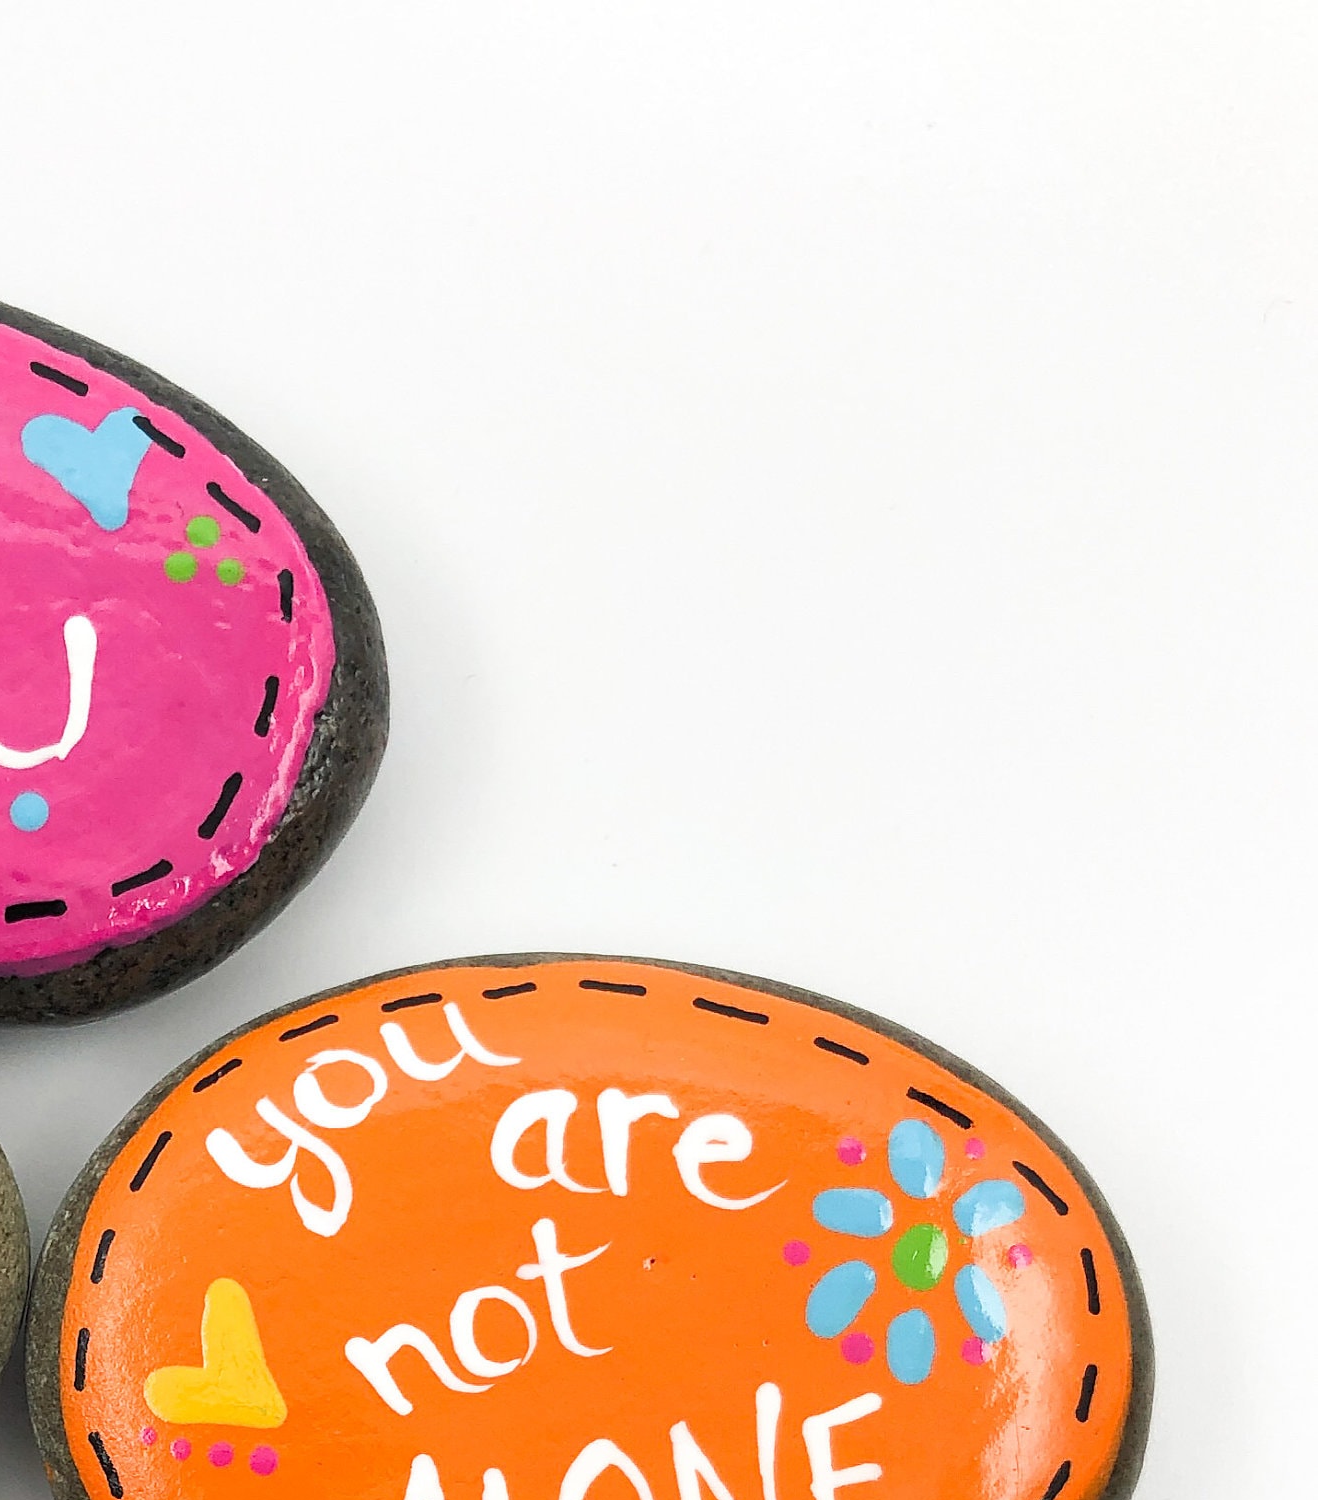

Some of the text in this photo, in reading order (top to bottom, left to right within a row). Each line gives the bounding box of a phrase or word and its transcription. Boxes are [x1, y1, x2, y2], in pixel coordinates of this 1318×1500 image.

[205, 1002, 787, 1237] you are
[344, 1217, 612, 1418] not
